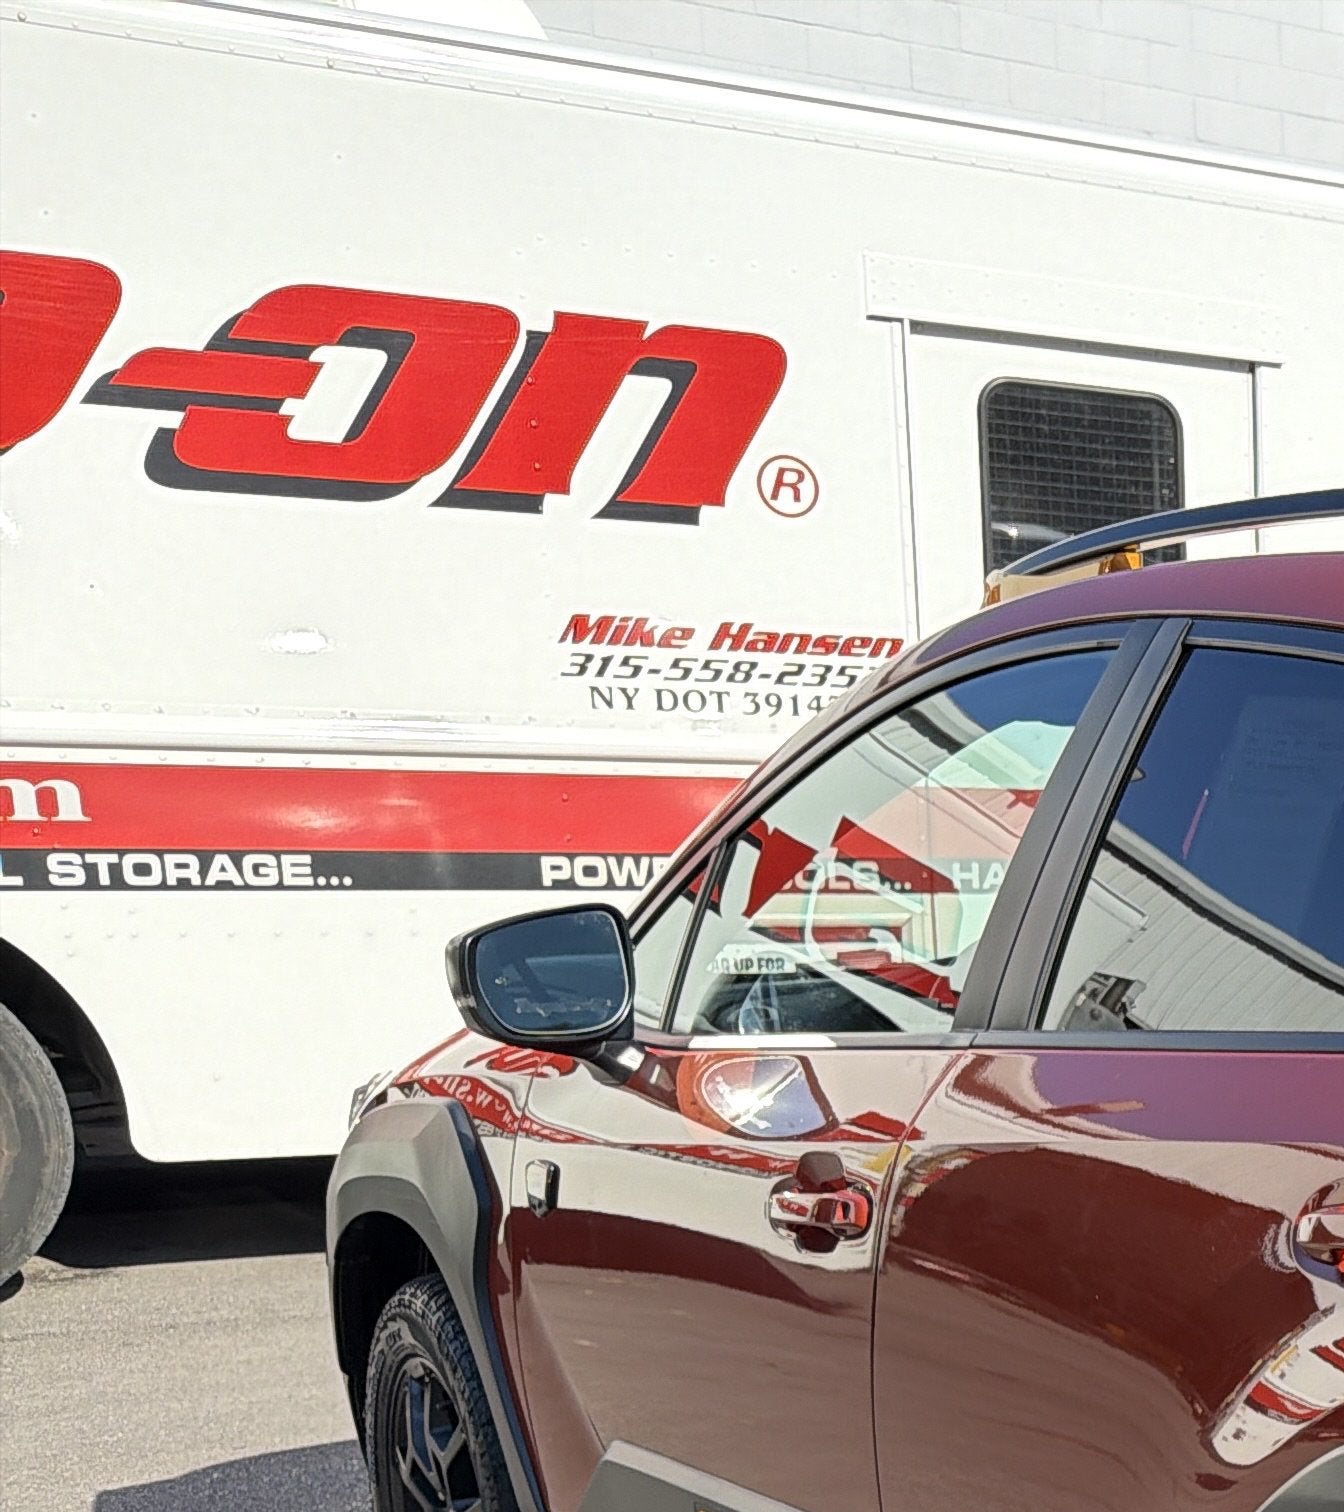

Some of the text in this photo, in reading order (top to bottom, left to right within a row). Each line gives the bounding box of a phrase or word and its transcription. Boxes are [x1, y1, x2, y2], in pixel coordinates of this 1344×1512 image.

[558, 613, 905, 660] Mike Hansen
[589, 686, 640, 710] NY
[655, 688, 730, 713] DOT
[46, 853, 353, 887] STORAGE...
